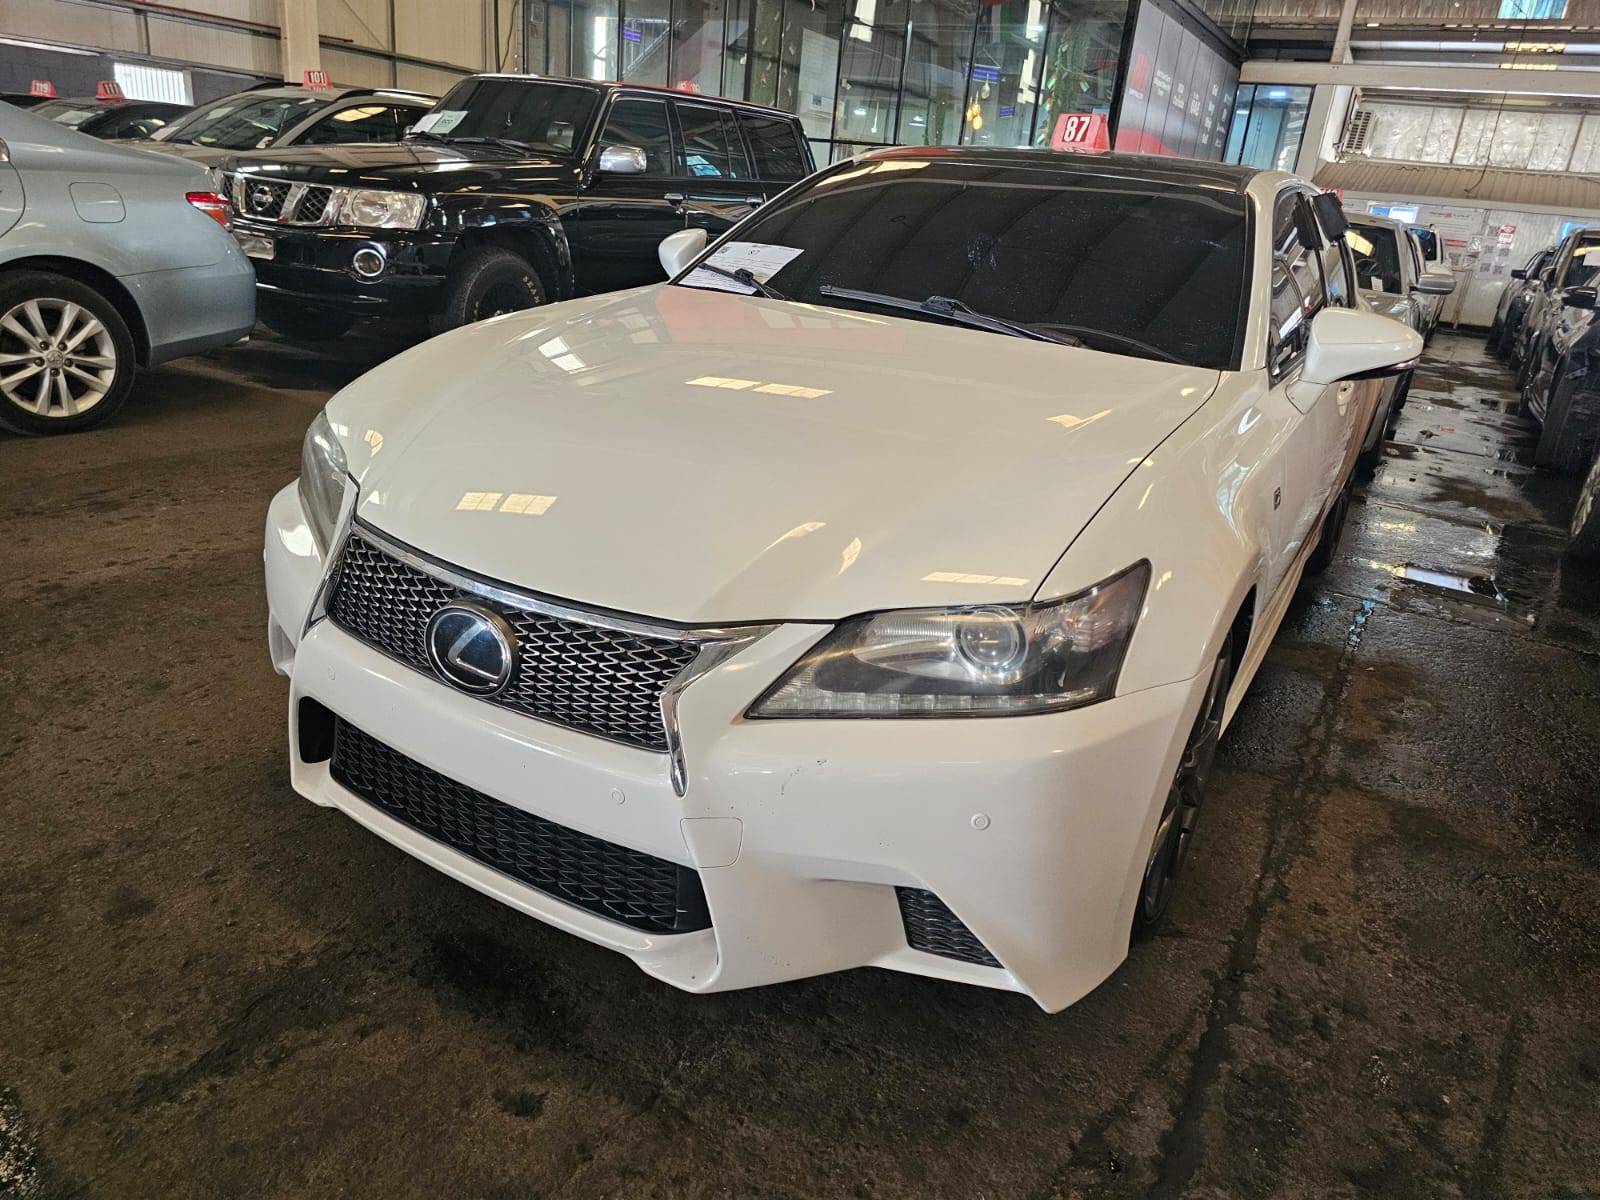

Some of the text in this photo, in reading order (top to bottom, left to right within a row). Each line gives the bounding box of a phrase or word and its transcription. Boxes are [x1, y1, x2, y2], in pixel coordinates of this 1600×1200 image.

[310, 71, 324, 84] 101
[104, 83, 119, 95] 111
[1063, 116, 1091, 142] 87
